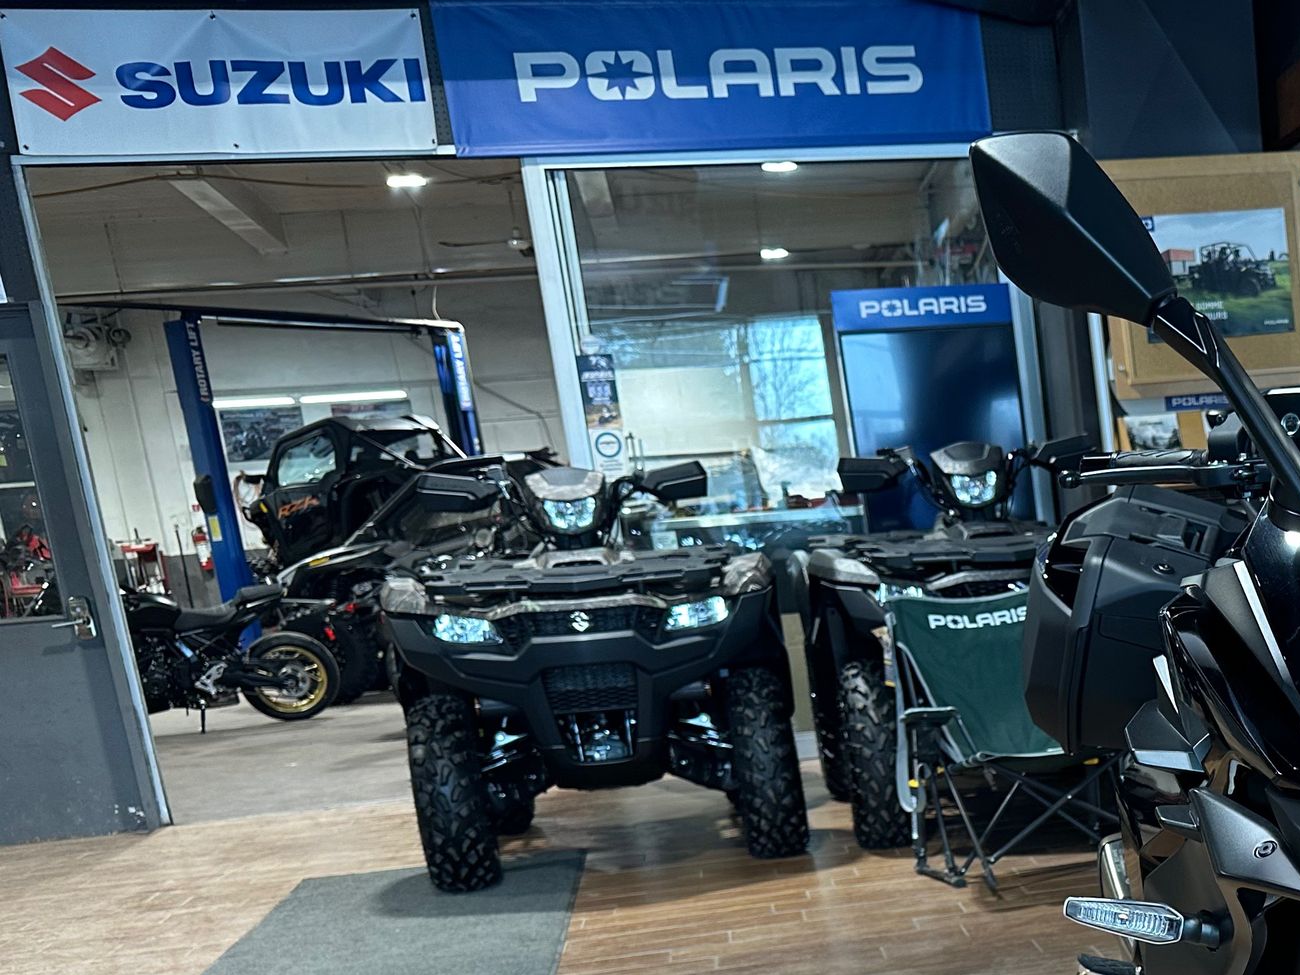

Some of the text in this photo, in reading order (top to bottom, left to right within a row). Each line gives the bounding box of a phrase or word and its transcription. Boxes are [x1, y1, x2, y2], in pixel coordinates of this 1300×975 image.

[116, 58, 426, 109] SUZUKI
[513, 45, 923, 102] POLARIS
[859, 295, 987, 318] POLARIS
[185, 320, 209, 395] ROTARY LIFT
[927, 606, 1028, 630] POLARIS
